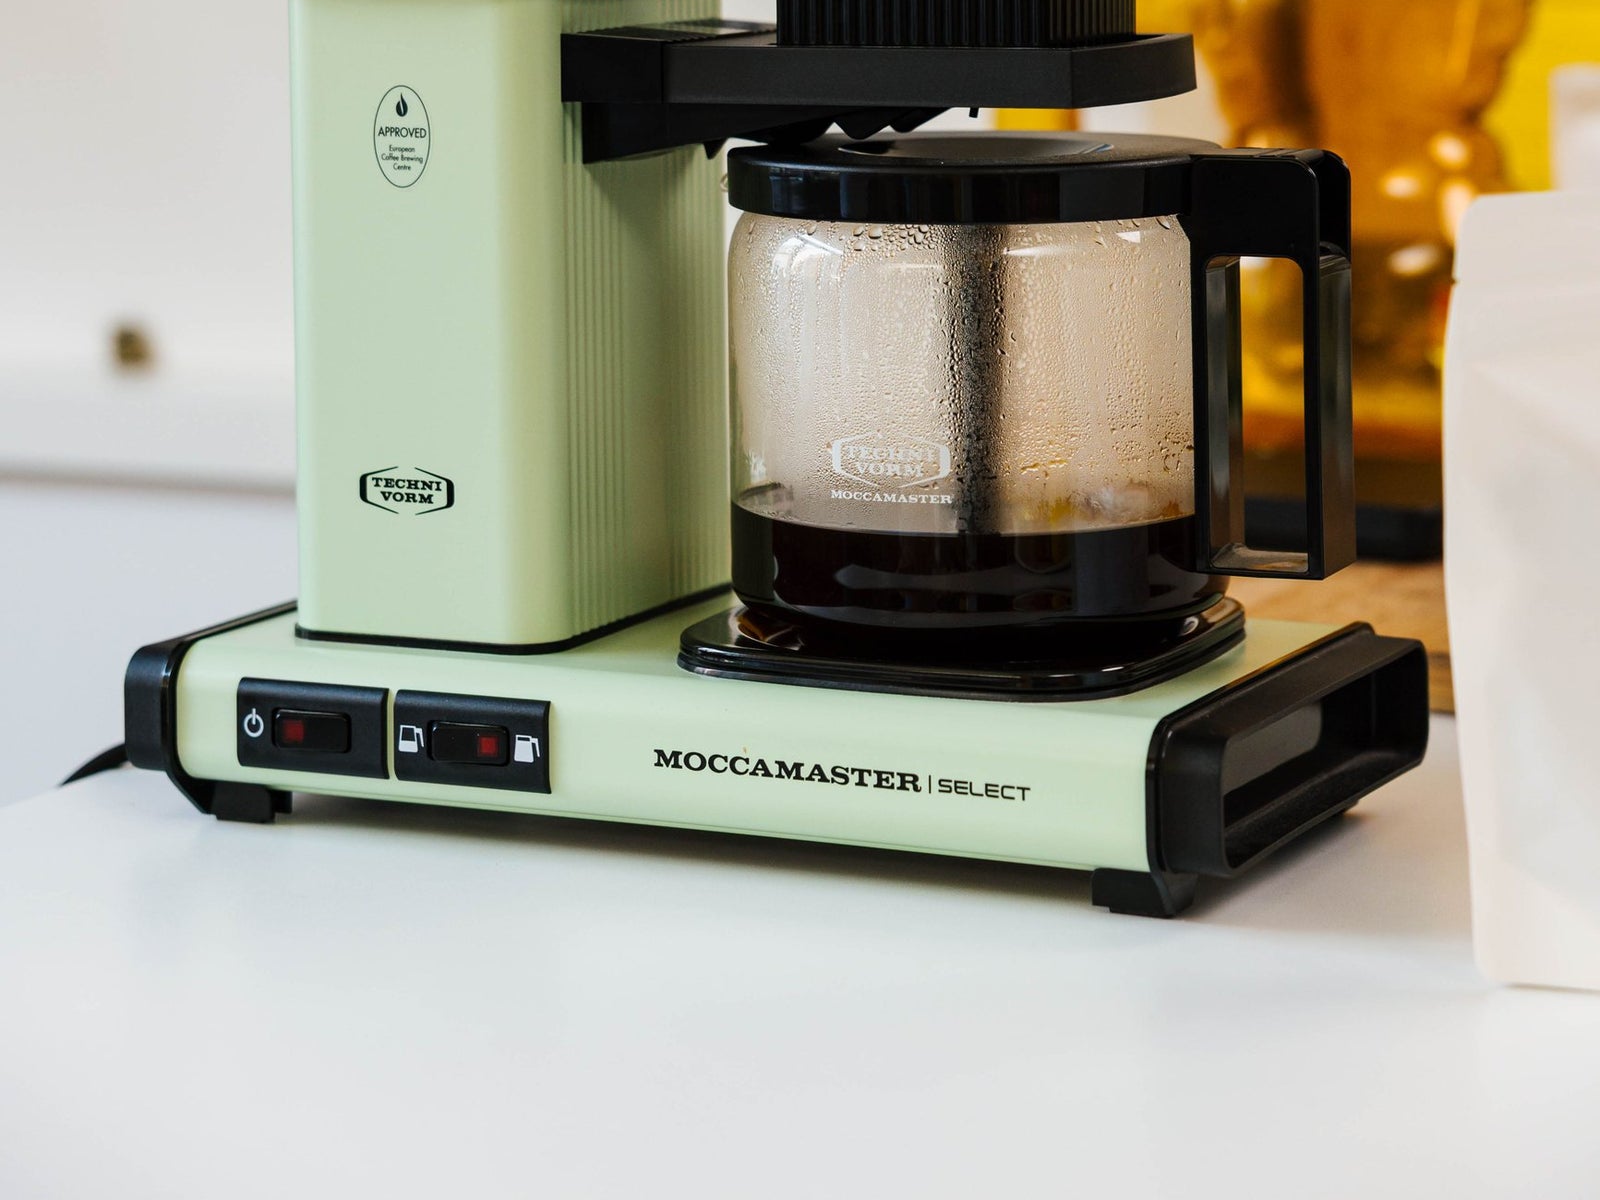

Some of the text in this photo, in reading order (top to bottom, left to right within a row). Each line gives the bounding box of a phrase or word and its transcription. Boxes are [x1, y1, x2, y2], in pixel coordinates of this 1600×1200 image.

[378, 126, 427, 138] APPROVED
[389, 145, 415, 153] European
[381, 153, 423, 164] Coffee Brewing
[393, 163, 411, 171] Centre
[371, 477, 442, 491] TECHNI
[380, 491, 434, 504] VORM
[831, 489, 953, 504] MOCCAMASTER
[653, 748, 1031, 801] MOCCAMASTER SELECT
